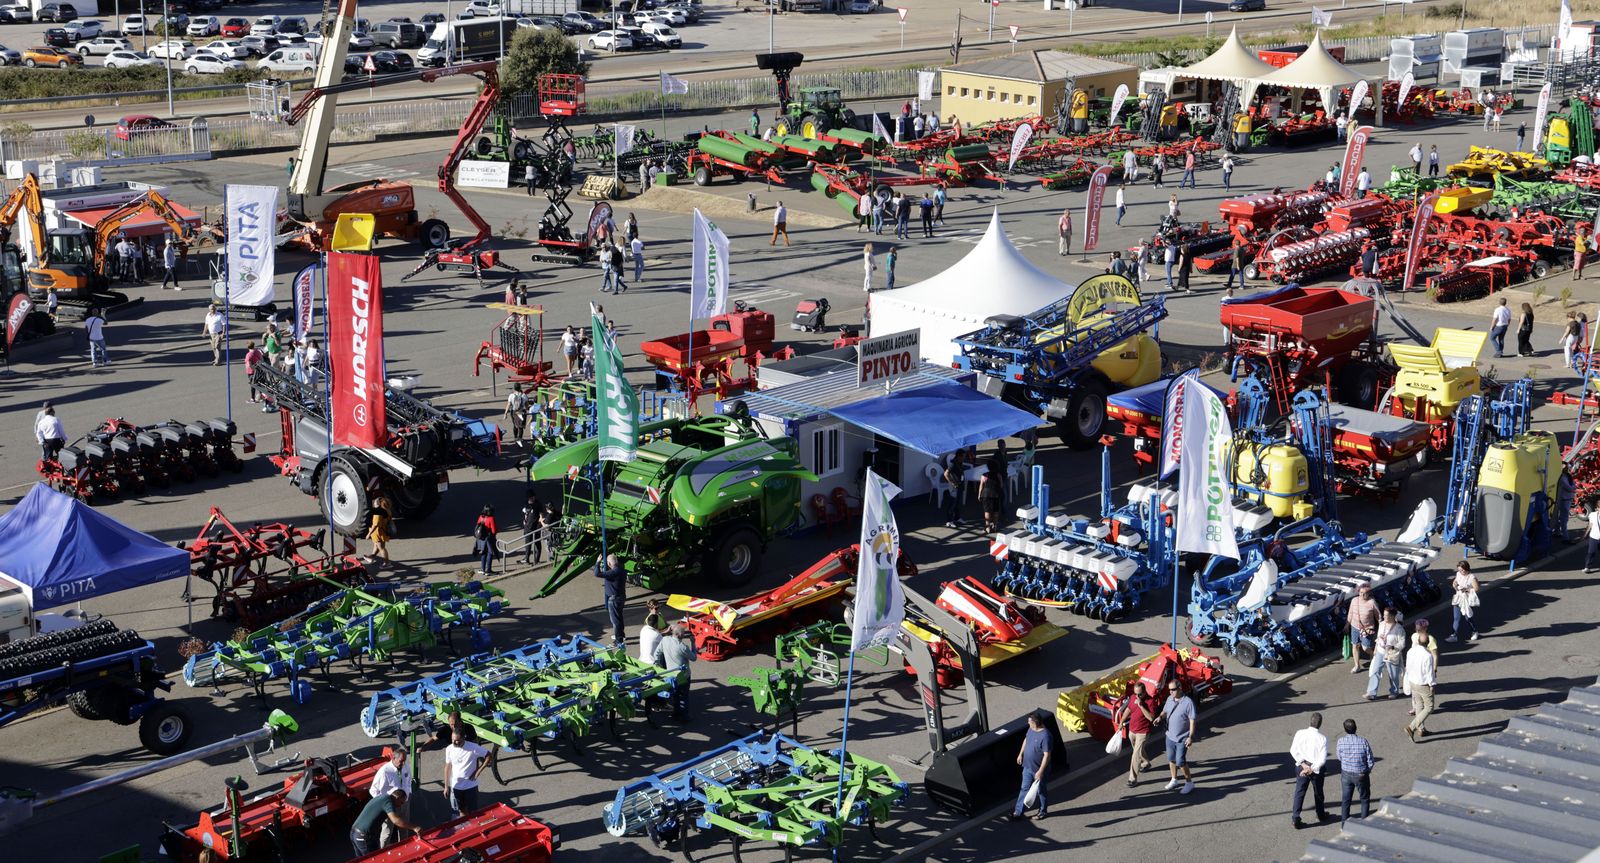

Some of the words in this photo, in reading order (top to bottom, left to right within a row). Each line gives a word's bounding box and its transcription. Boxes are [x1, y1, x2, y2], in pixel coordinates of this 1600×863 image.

[239, 202, 259, 259] PITA
[351, 276, 369, 401] HORSCH
[863, 338, 894, 357] MAQUINARIA
[895, 333, 917, 350] AGRICOLA
[862, 351, 911, 382] PINTO
[60, 577, 97, 598] PITA
